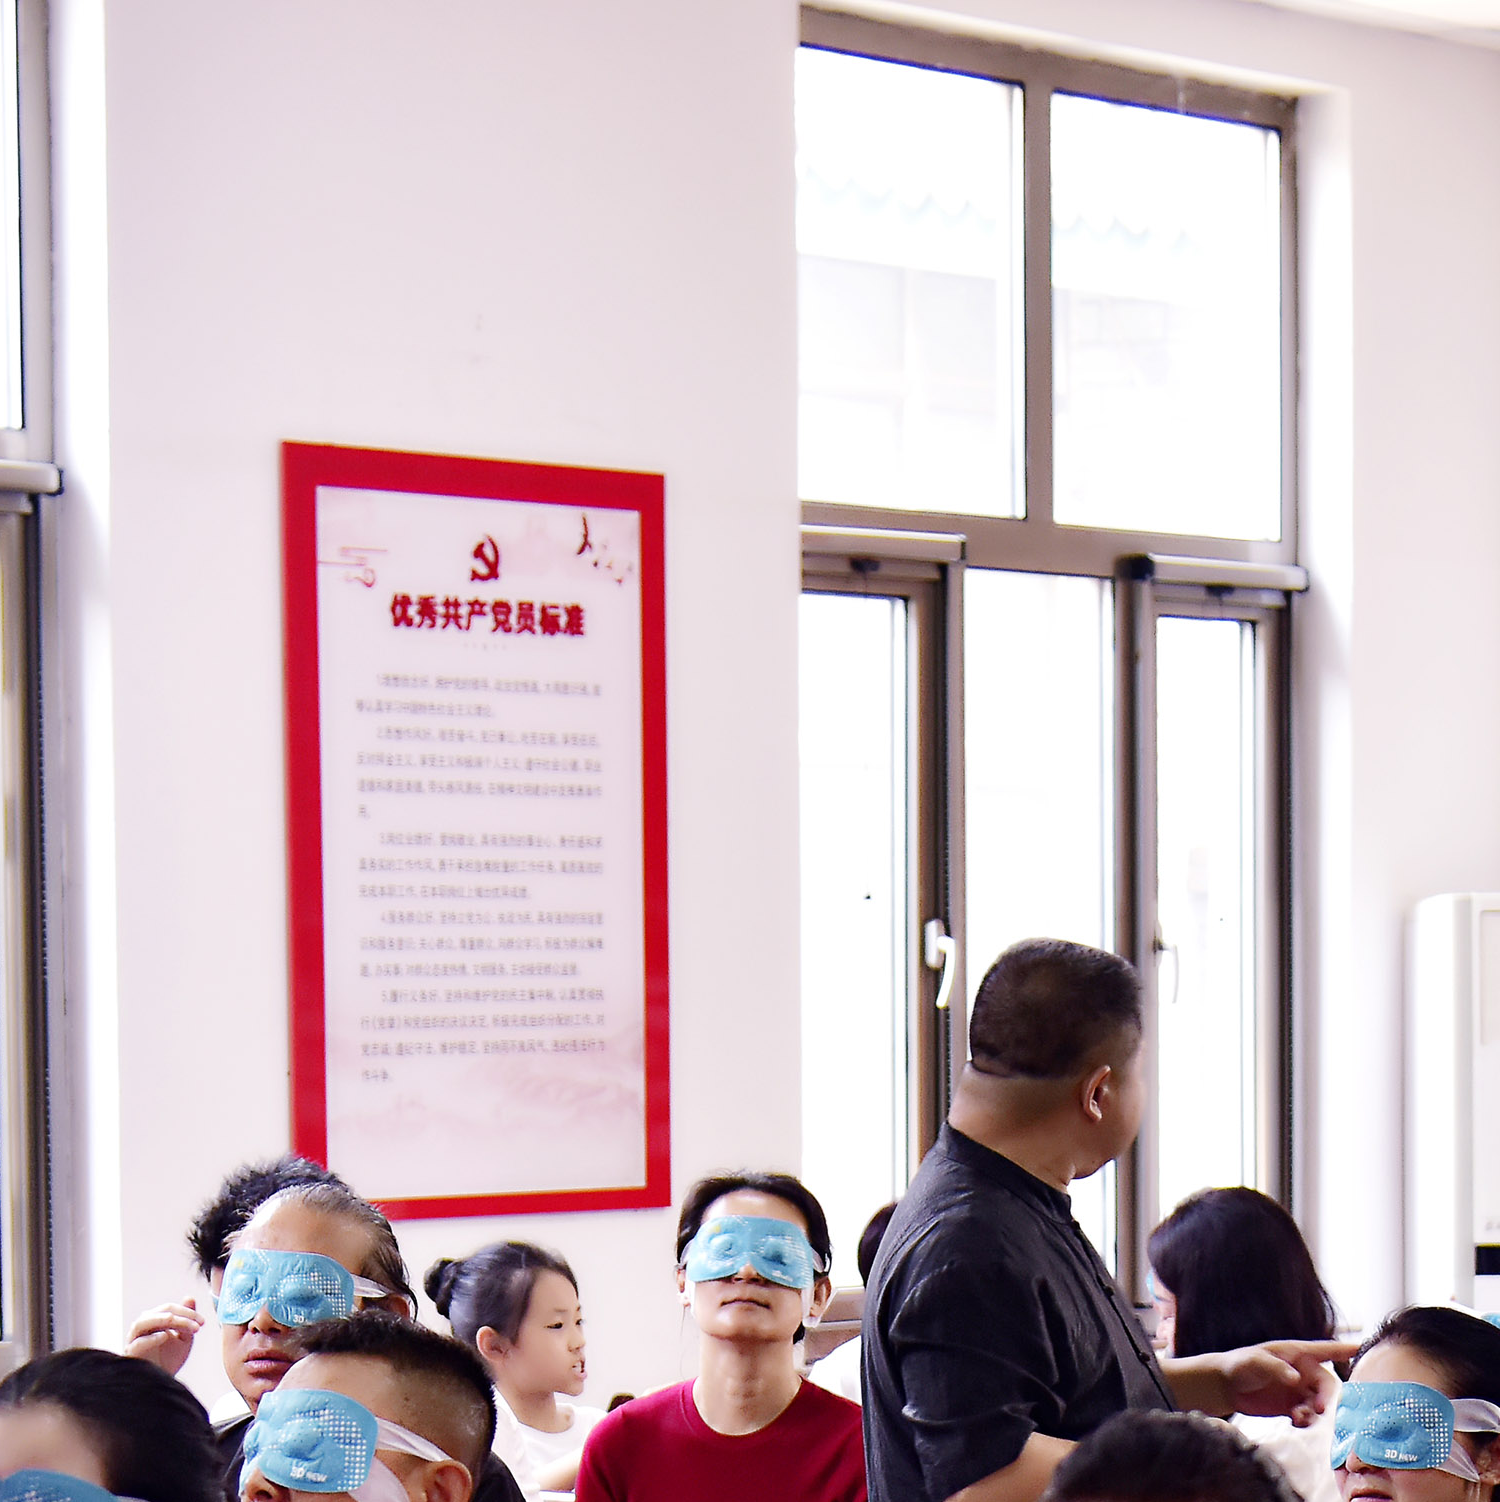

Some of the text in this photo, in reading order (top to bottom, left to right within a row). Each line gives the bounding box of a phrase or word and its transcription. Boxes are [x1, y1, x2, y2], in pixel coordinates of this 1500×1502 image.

[389, 592, 586, 637] 优秀共产党员标准
[1384, 1449, 1398, 1459] 3D
